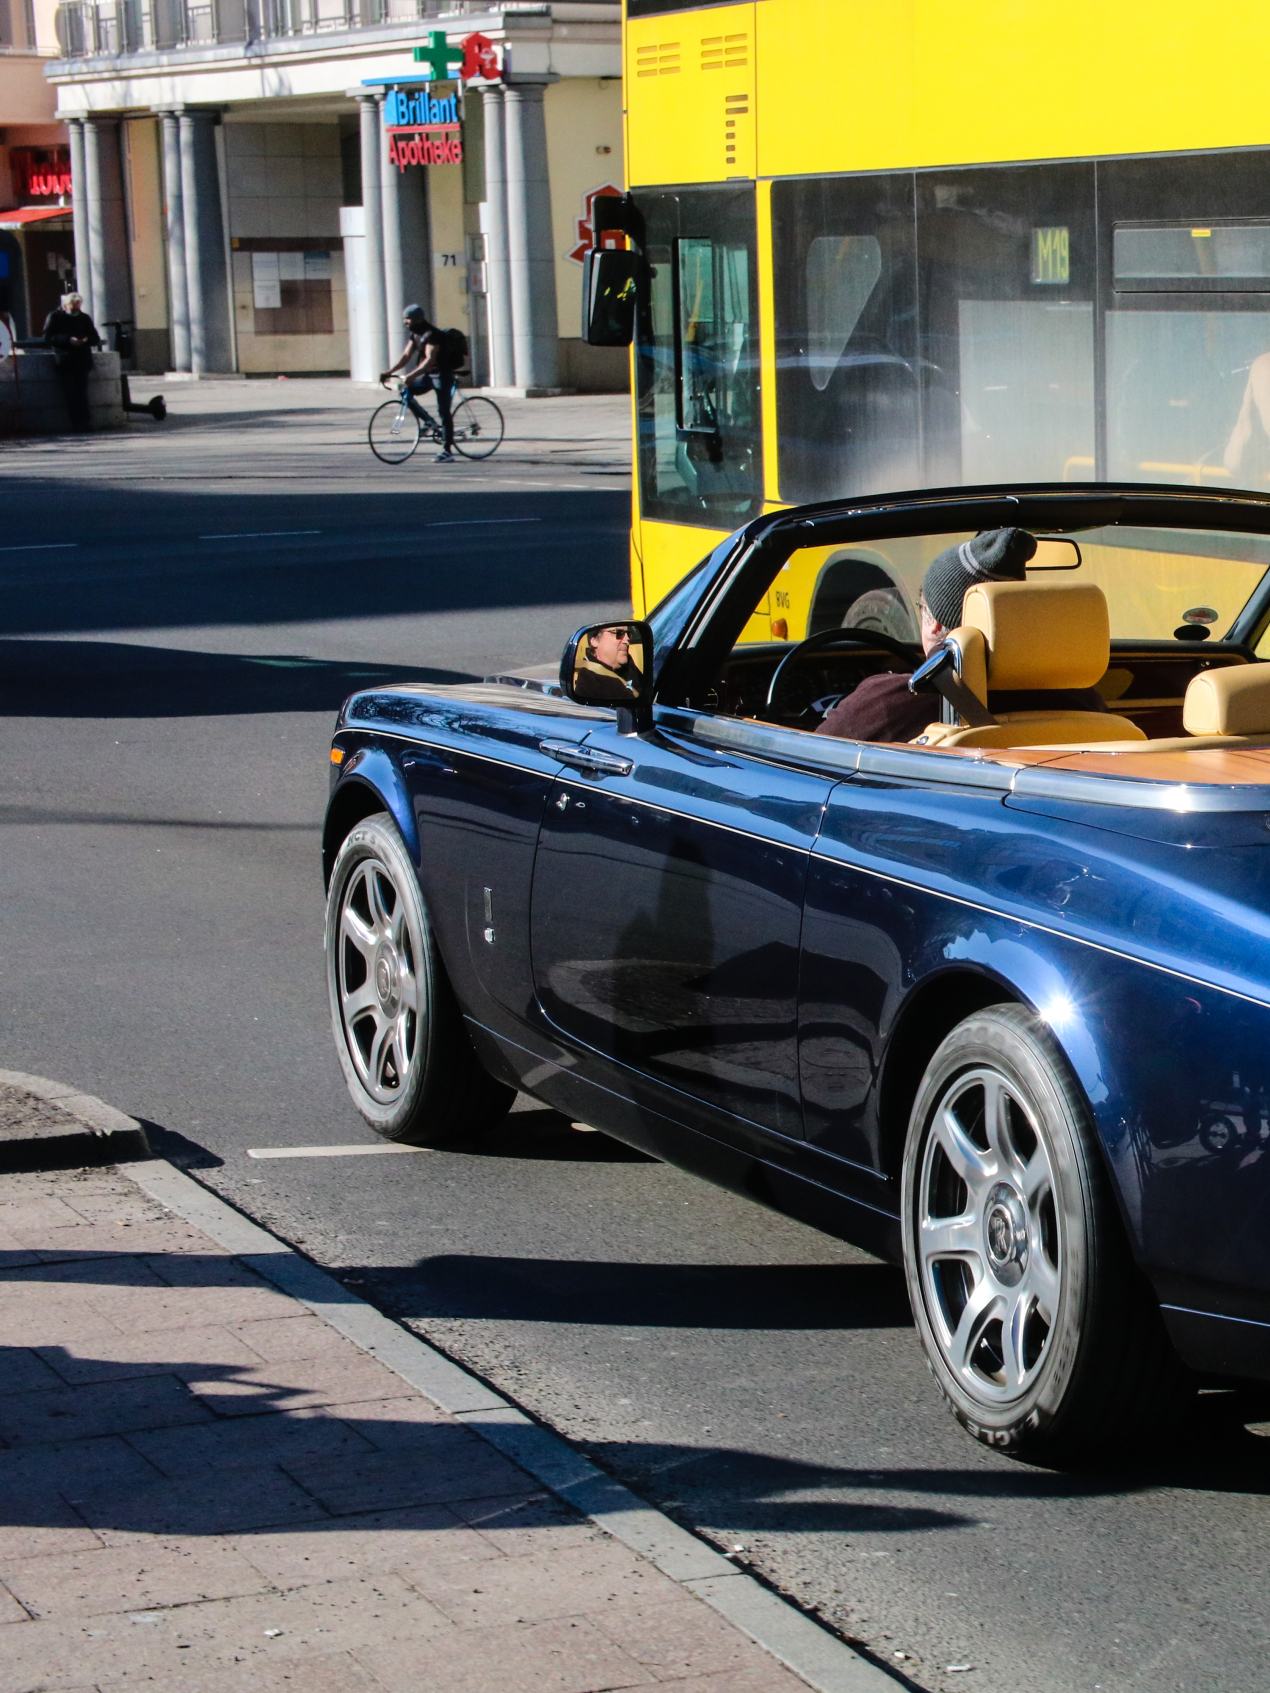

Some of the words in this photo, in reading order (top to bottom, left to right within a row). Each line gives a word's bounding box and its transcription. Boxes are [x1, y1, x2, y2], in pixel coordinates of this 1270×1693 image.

[397, 92, 459, 125] Brillant
[389, 132, 463, 173] Apotheke
[442, 254, 456, 267] 71
[1037, 229, 1069, 280] M19
[776, 591, 790, 609] BVG
